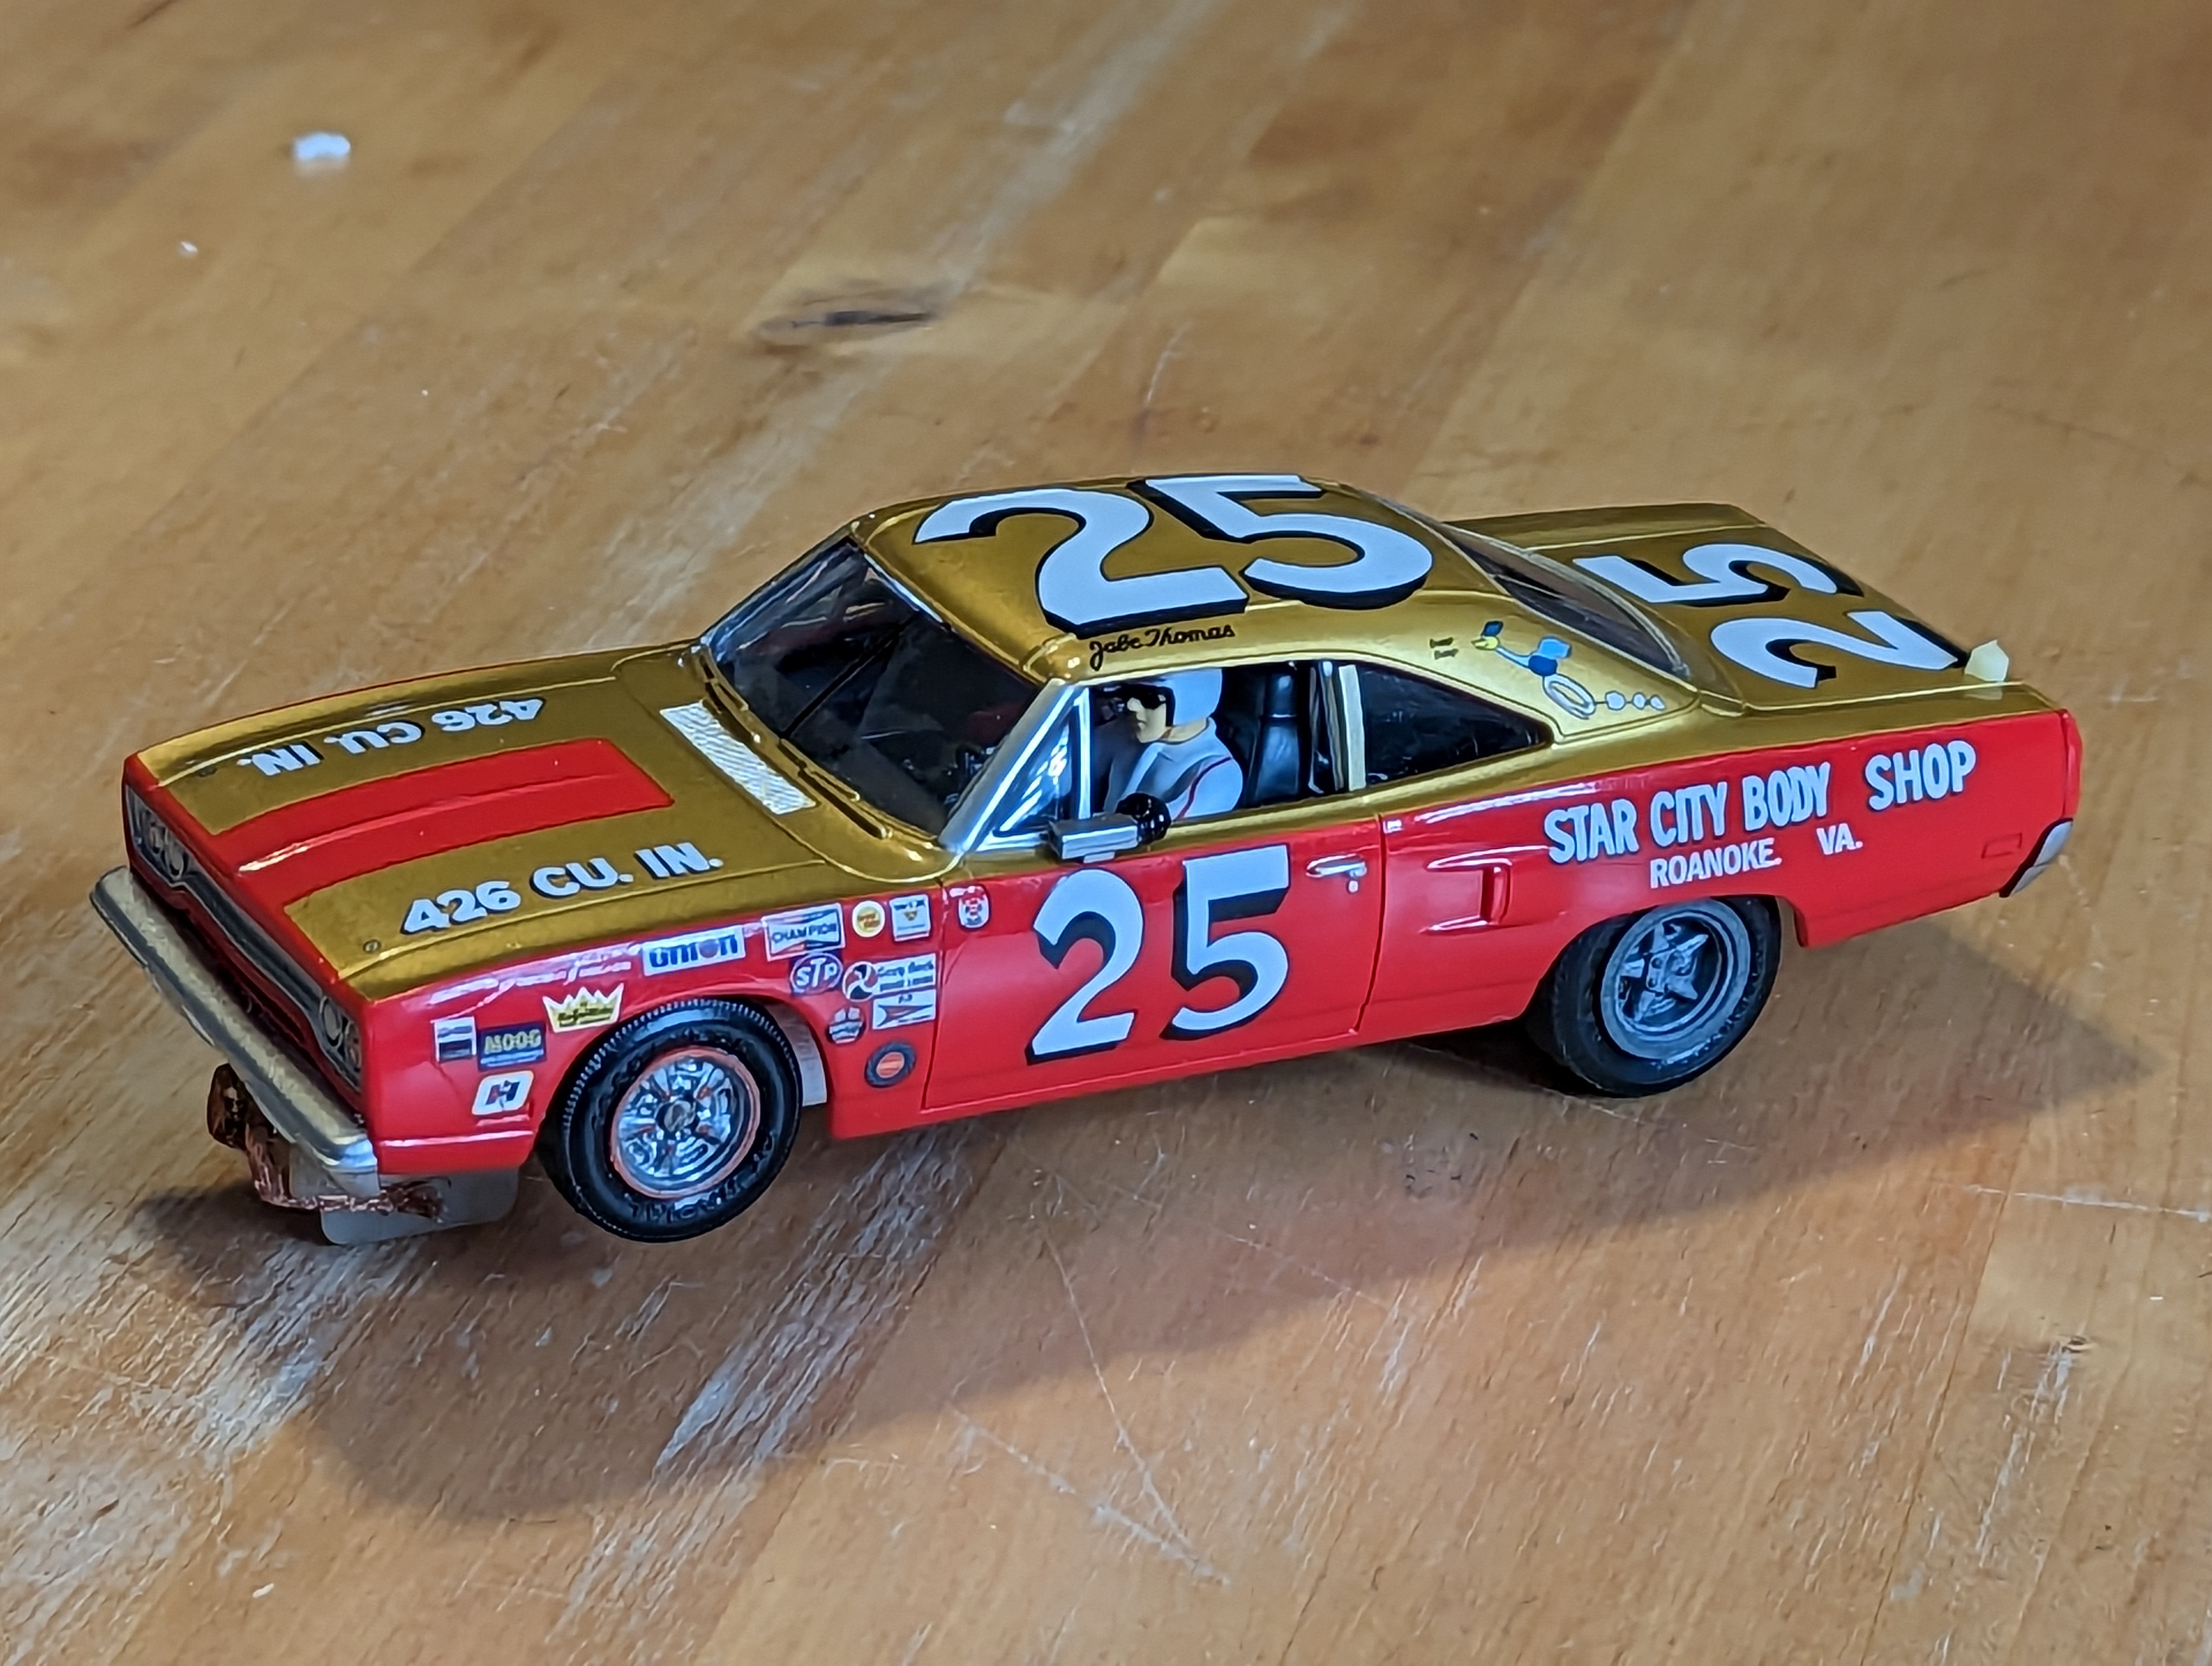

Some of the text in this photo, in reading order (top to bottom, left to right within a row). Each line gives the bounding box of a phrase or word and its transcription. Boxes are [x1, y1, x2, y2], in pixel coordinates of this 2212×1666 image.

[913, 473, 1434, 639] 25
[1144, 624, 1236, 646] Thomas
[1572, 542, 1969, 689] 25
[432, 698, 546, 732] 426
[1544, 740, 1977, 864] STAR CITY BODY SHOP
[1816, 823, 1863, 855] VA.
[400, 842, 724, 935] 426 CU. IN.
[796, 957, 838, 988] STP
[1025, 844, 1291, 1066] 25
